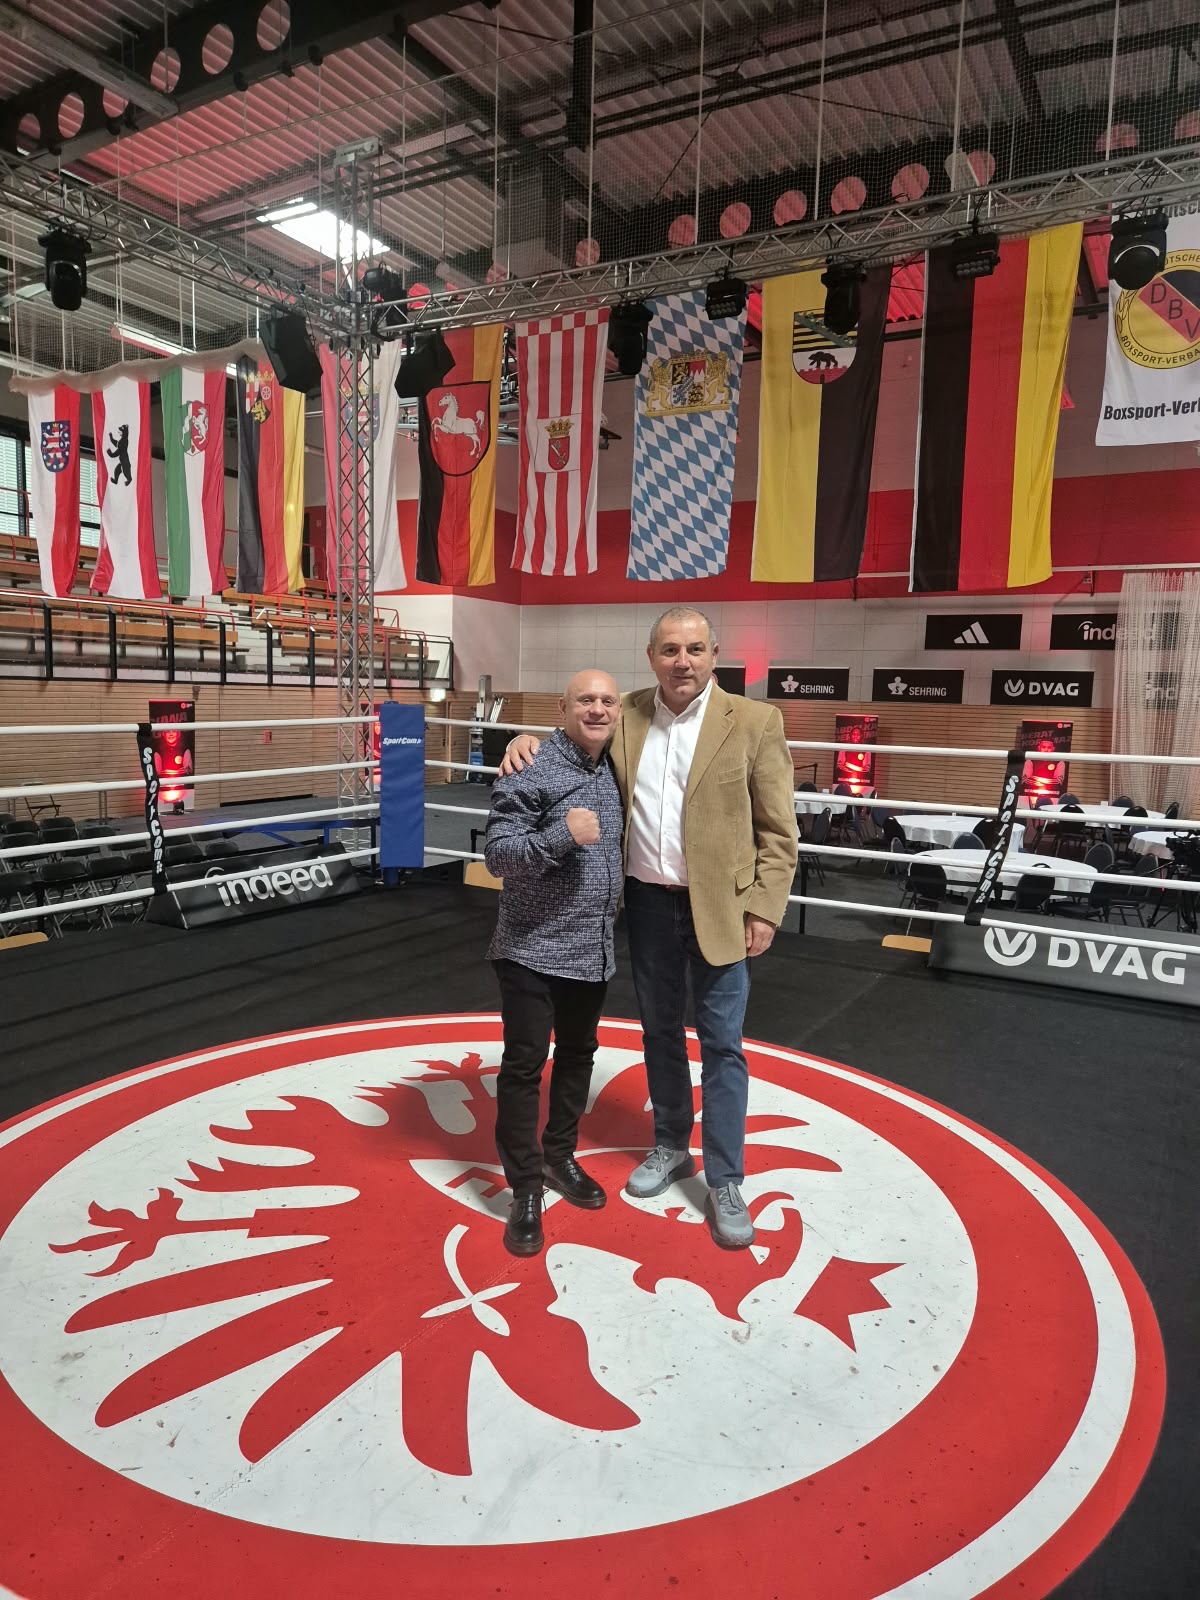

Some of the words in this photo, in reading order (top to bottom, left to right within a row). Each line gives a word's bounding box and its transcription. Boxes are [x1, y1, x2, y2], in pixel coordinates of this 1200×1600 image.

[1103, 396, 1200, 421] Boxsport-Ver
[800, 684, 834, 695] SEHRING
[908, 686, 947, 697] SEHRING
[1028, 682, 1080, 696] DVAG
[383, 737, 417, 746] SportCom
[216, 856, 333, 907] indeed
[1047, 936, 1187, 985] DVAG
